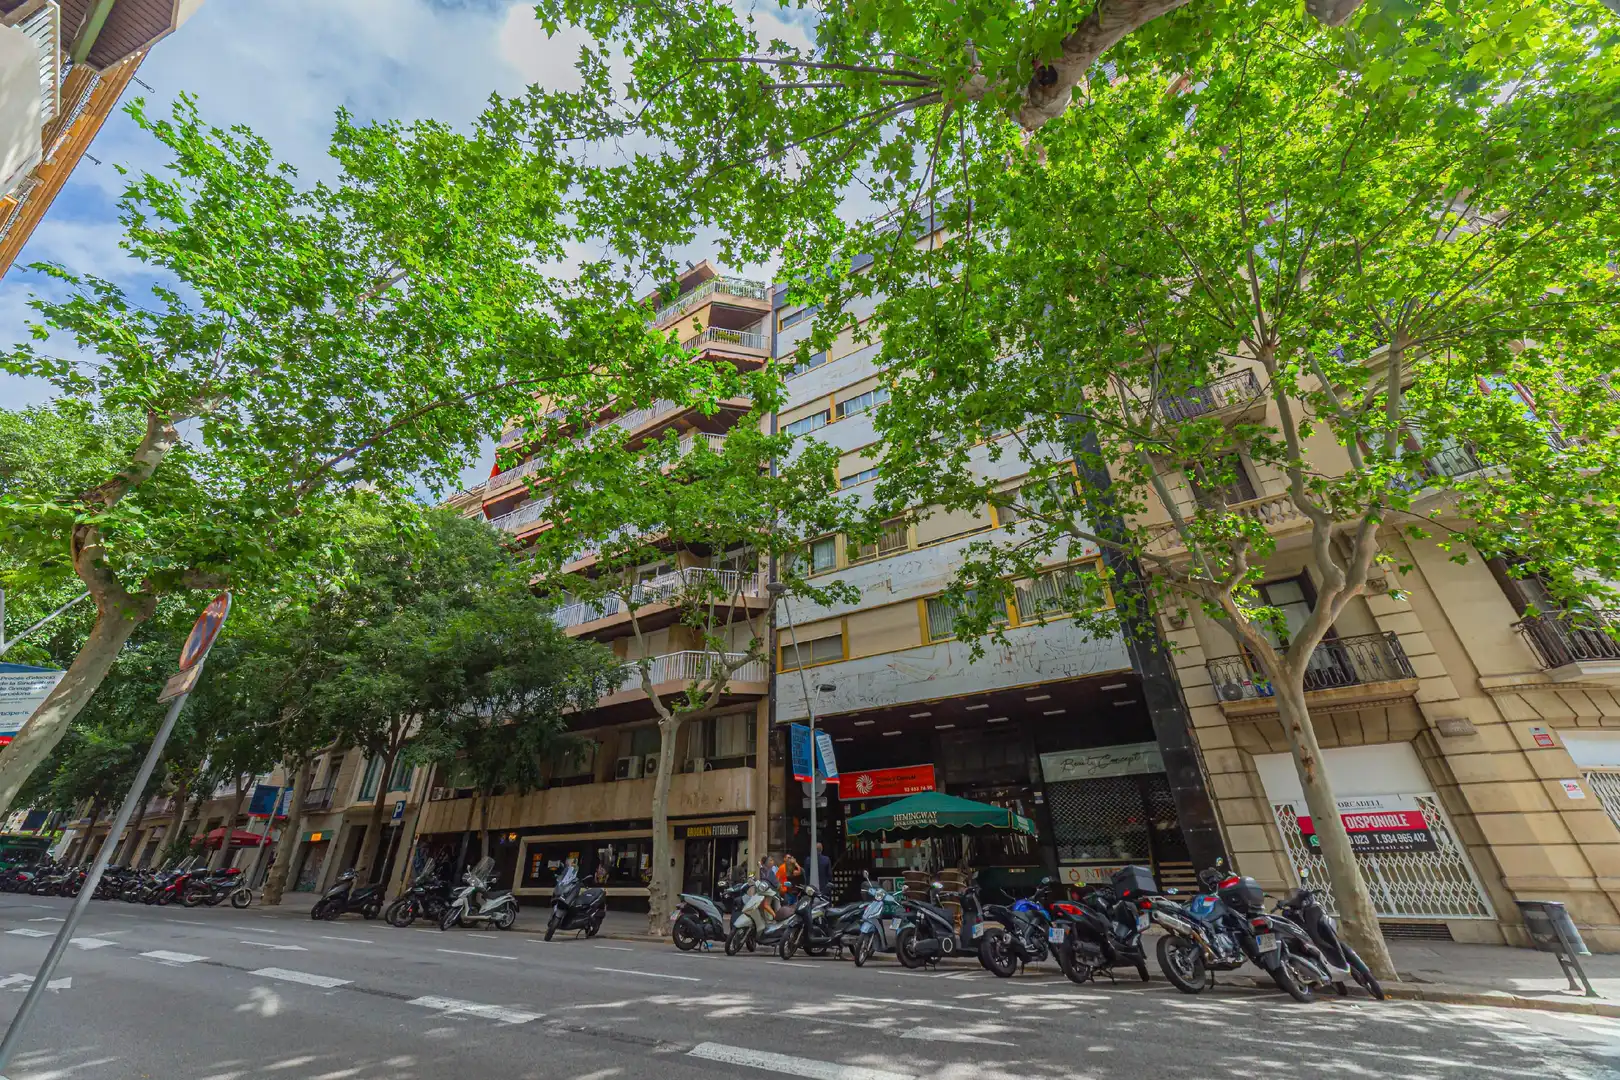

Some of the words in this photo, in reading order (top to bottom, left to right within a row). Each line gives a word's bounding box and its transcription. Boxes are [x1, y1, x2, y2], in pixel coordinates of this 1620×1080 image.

[392, 801, 403, 818] P
[1336, 799, 1383, 808] ORCADELL
[893, 811, 938, 822] HEMINGWAY
[1344, 814, 1410, 829] DISPONIBLE
[687, 826, 712, 837] BROOKLYN
[712, 824, 739, 836] FITBOXING
[1354, 834, 1370, 845] 023
[1397, 833, 1414, 843] 965
[1413, 832, 1428, 843] 412
